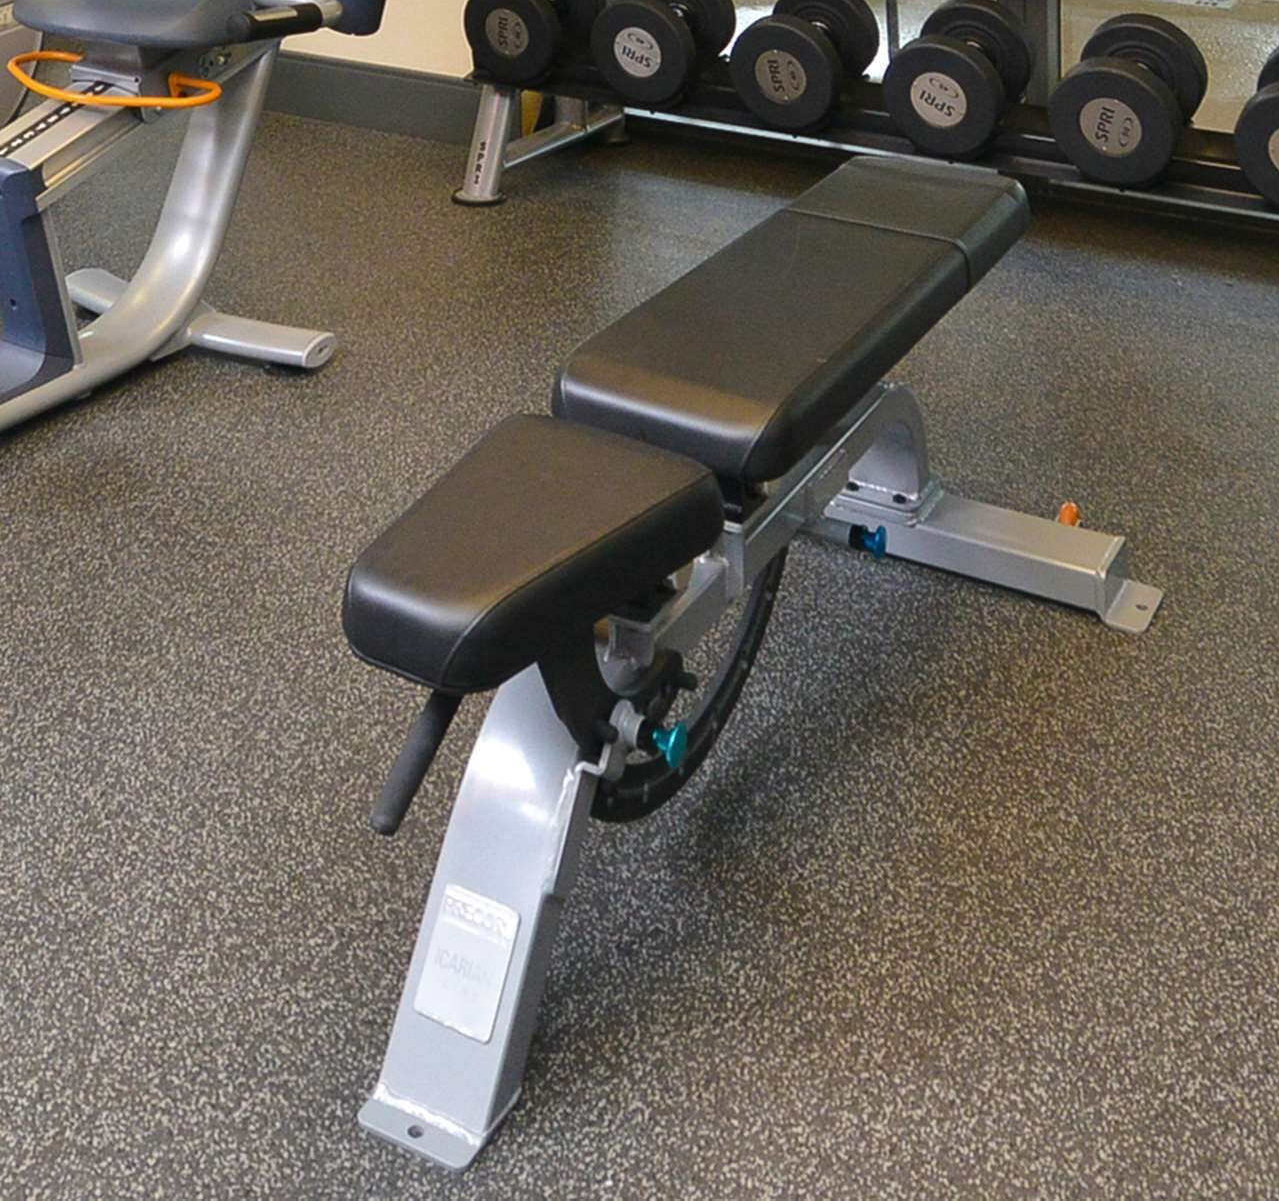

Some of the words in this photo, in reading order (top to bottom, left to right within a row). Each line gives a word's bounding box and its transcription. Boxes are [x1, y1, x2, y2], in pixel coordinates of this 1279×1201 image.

[497, 16, 509, 47] SPRI
[621, 45, 653, 69] SPRI
[768, 59, 785, 93] SPRI
[920, 89, 956, 118] SPRI
[1095, 106, 1116, 143] SPRI
